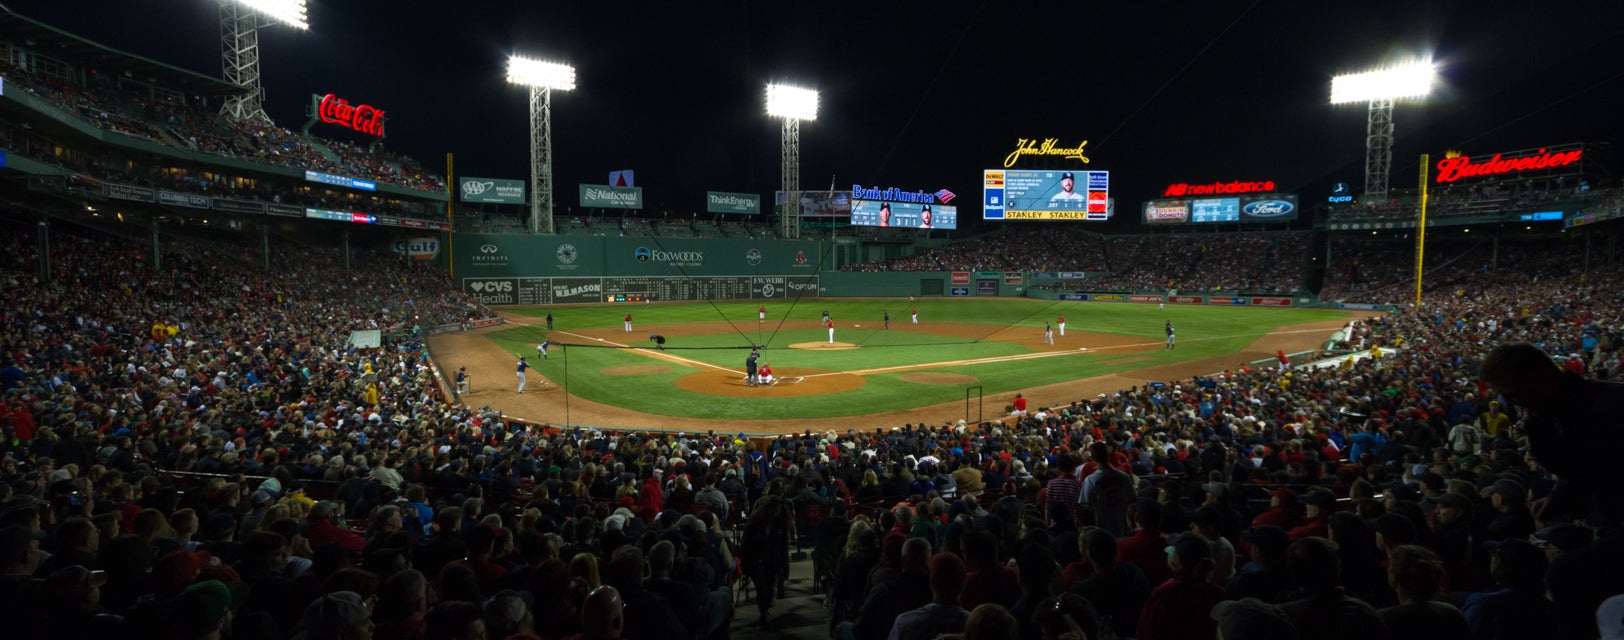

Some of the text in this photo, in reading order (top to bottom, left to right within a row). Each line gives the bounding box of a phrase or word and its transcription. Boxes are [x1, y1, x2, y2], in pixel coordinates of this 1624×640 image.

[1436, 147, 1584, 184] Budweiser
[1215, 181, 1275, 194] balance
[597, 190, 637, 201] National
[853, 185, 934, 204] Bank of America
[710, 195, 755, 208] ThinkEnergy
[1252, 202, 1284, 216] Ford
[652, 249, 703, 262] FOXWOODS
[484, 281, 513, 293] CVS
[473, 293, 514, 304] Health
